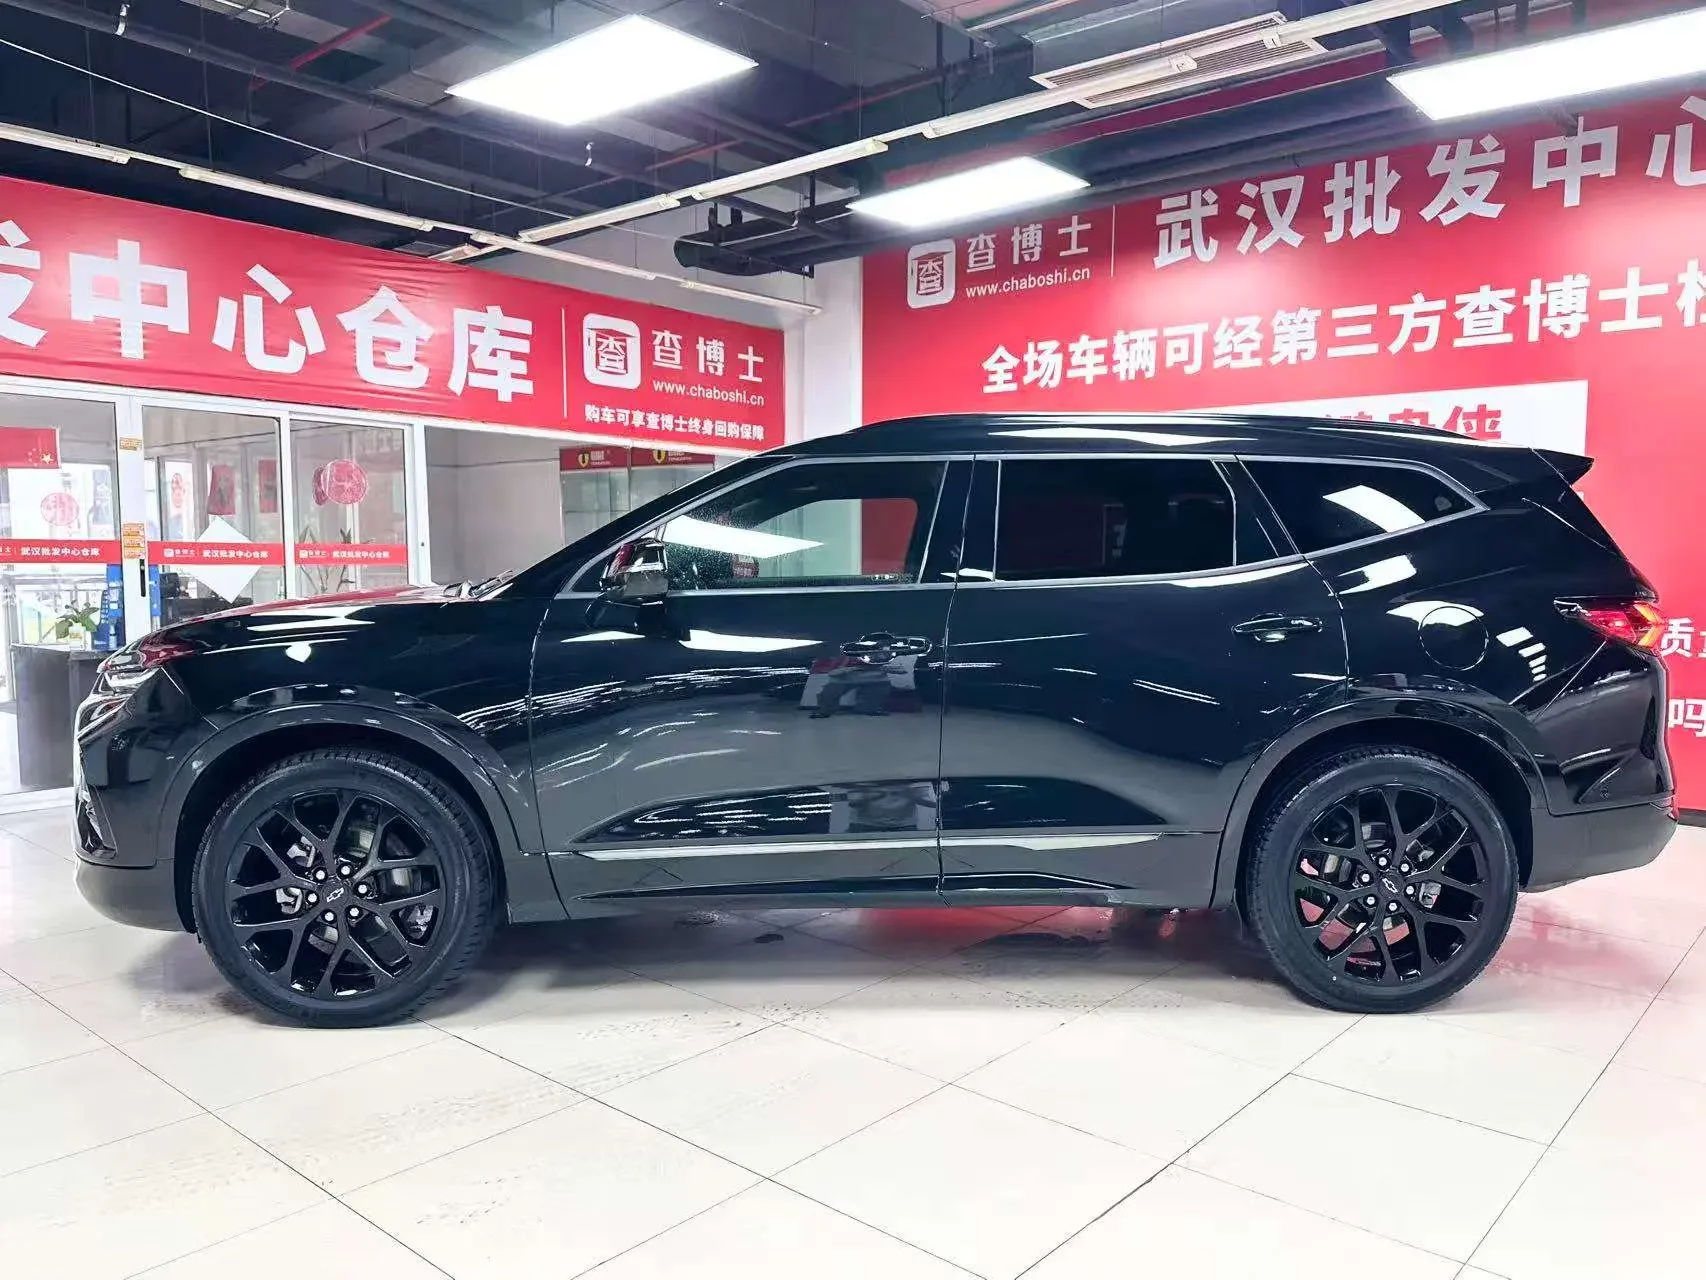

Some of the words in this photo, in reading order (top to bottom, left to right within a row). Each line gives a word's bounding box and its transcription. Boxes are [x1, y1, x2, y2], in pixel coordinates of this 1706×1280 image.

[1153, 95, 1706, 270] 武汉批发中心
[966, 215, 1092, 273] 查博士
[966, 267, 1091, 298] www.chaboshi.cn
[651, 329, 765, 383] 查博士
[652, 379, 765, 406] www.chaboshi.cn
[584, 404, 765, 441] 购车可享查博士终身回购保障
[1661, 617, 1706, 658] 质
